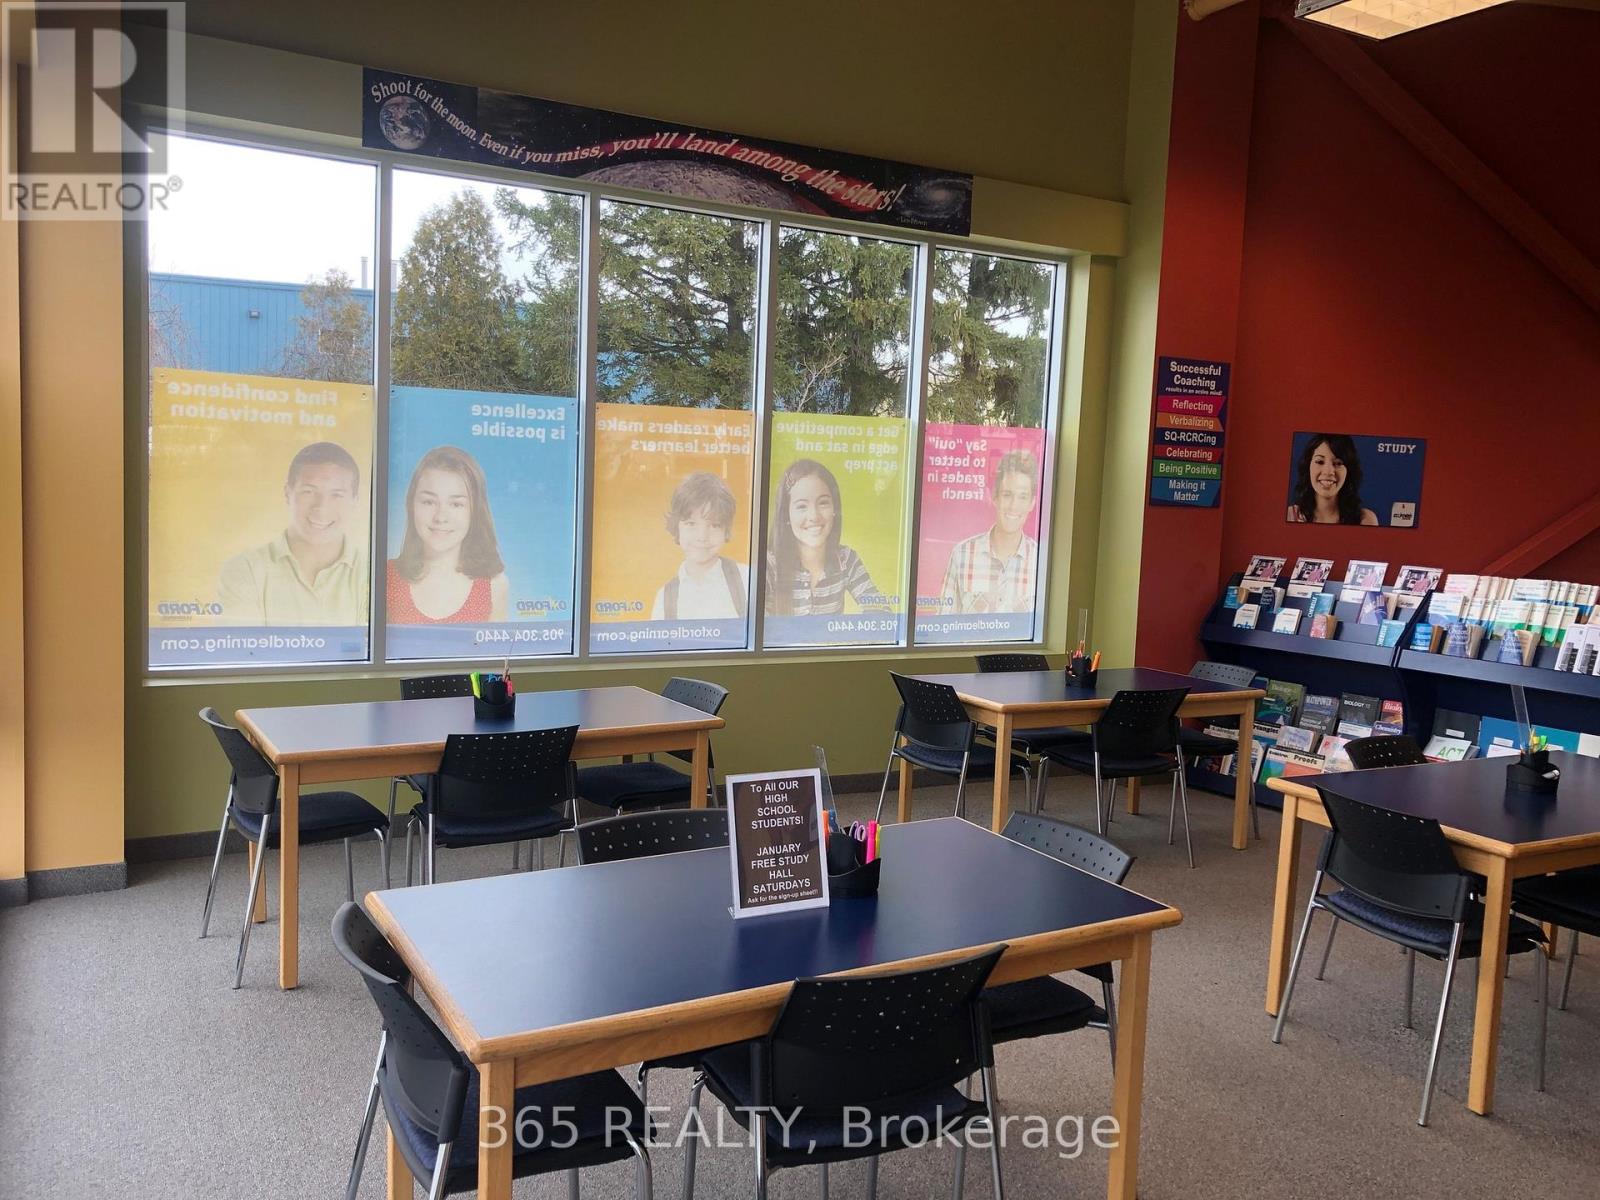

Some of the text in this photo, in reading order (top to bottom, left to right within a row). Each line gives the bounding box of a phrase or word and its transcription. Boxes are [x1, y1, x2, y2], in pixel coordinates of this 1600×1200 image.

[371, 79, 907, 212] Shoot for the moon. Even if you miss, you'll land among the stars!
[1170, 361, 1222, 376] Successful
[1173, 374, 1216, 390] Coaching
[1172, 399, 1213, 414] Reflecting
[1169, 415, 1214, 430] Verbalizing
[1164, 431, 1217, 445] SQ-RCRCing
[1166, 447, 1213, 461] Celebrating
[1378, 443, 1416, 454] STUDY
[1159, 463, 1217, 475] Being Positive
[1169, 480, 1206, 492] Making it
[1173, 491, 1199, 501] Matter
[1344, 700, 1364, 708] BIOLOGY
[1375, 724, 1402, 736] Chemistry
[1440, 746, 1465, 757] ACT
[1294, 754, 1318, 765] Proofs
[750, 780, 799, 793] To All OUR
[764, 793, 788, 804] HIGH
[757, 804, 797, 817] SCHOOL
[751, 815, 804, 830] STUDENTS!
[756, 842, 801, 857] JANUARY
[751, 854, 810, 870] FREE STUDY
[769, 868, 794, 880] HALL
[753, 878, 811, 895] SATURDAYS
[778, 892, 799, 900] sign-up
